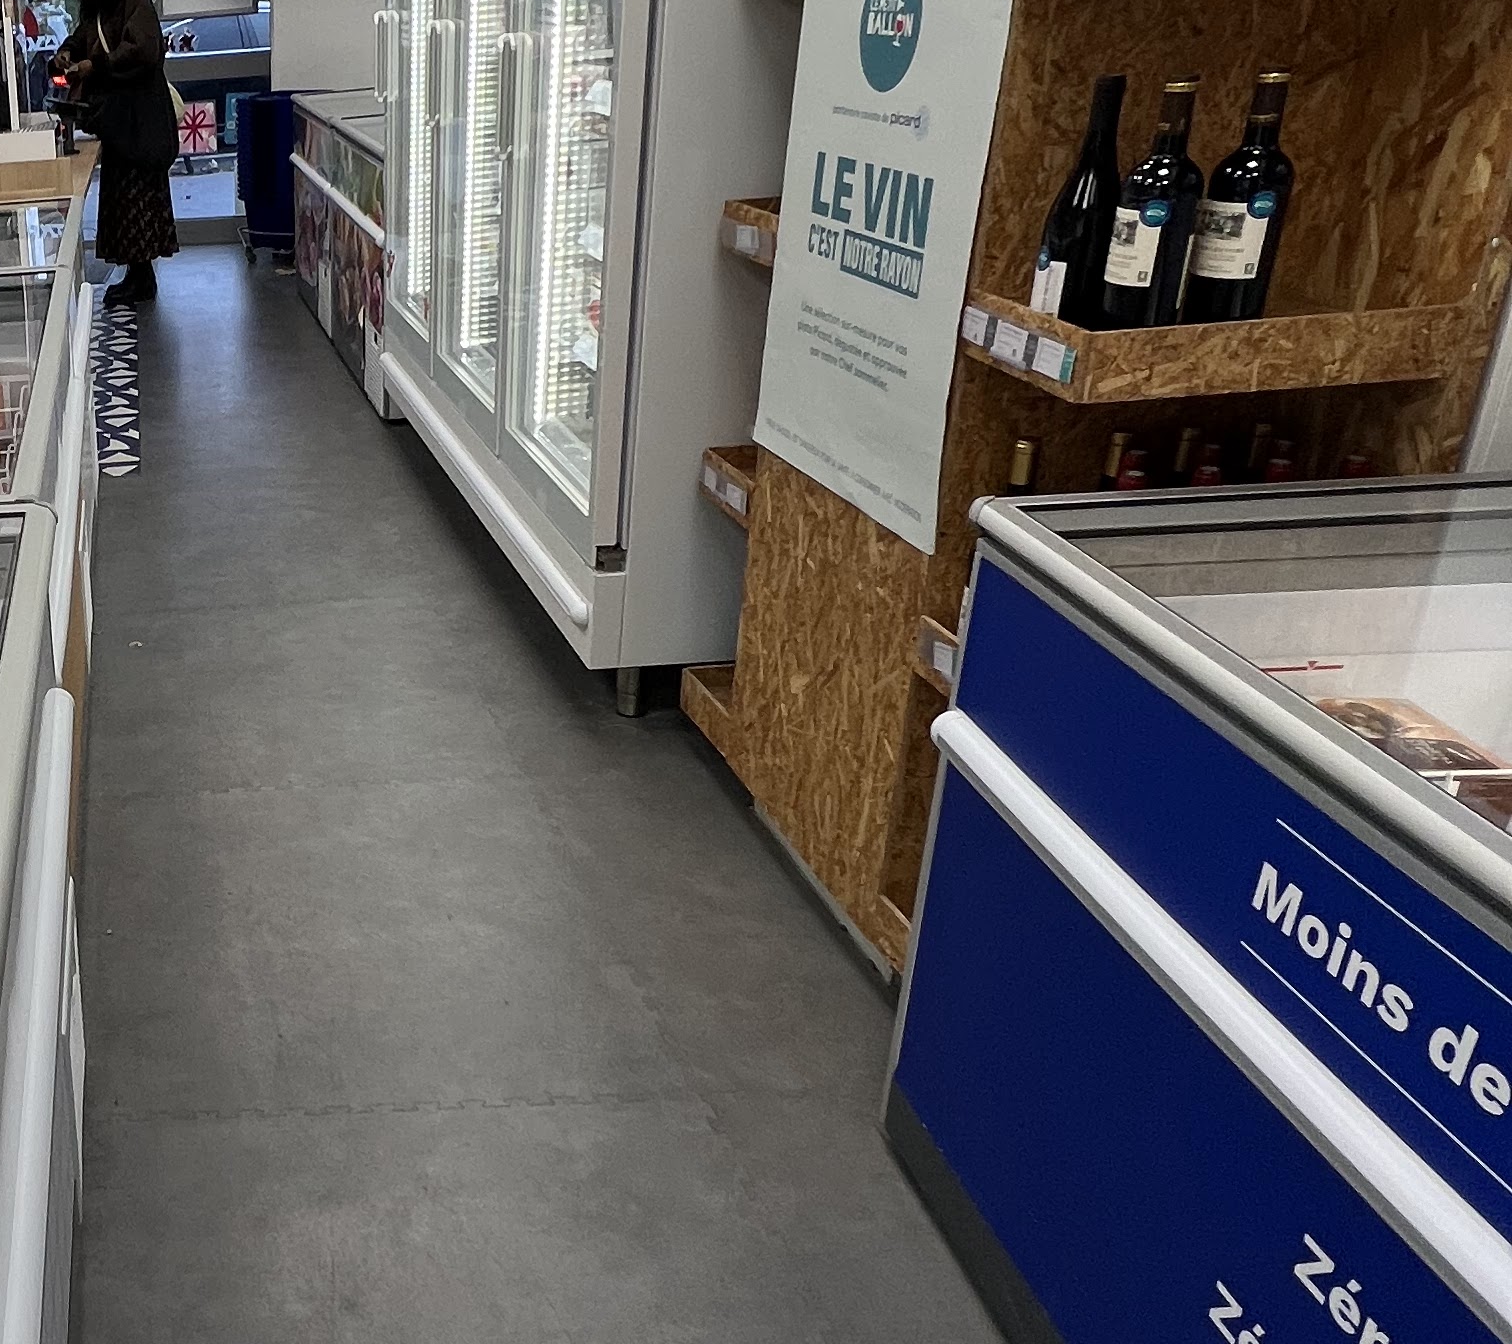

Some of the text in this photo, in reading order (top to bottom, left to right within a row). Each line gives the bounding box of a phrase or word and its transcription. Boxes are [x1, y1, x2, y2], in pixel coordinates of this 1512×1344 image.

[889, 112, 922, 129] picard
[811, 151, 934, 249] LE VIN
[808, 223, 839, 261] C'EST
[843, 235, 921, 294] NOTRE RAYON
[1251, 861, 1512, 1116] Moins de
